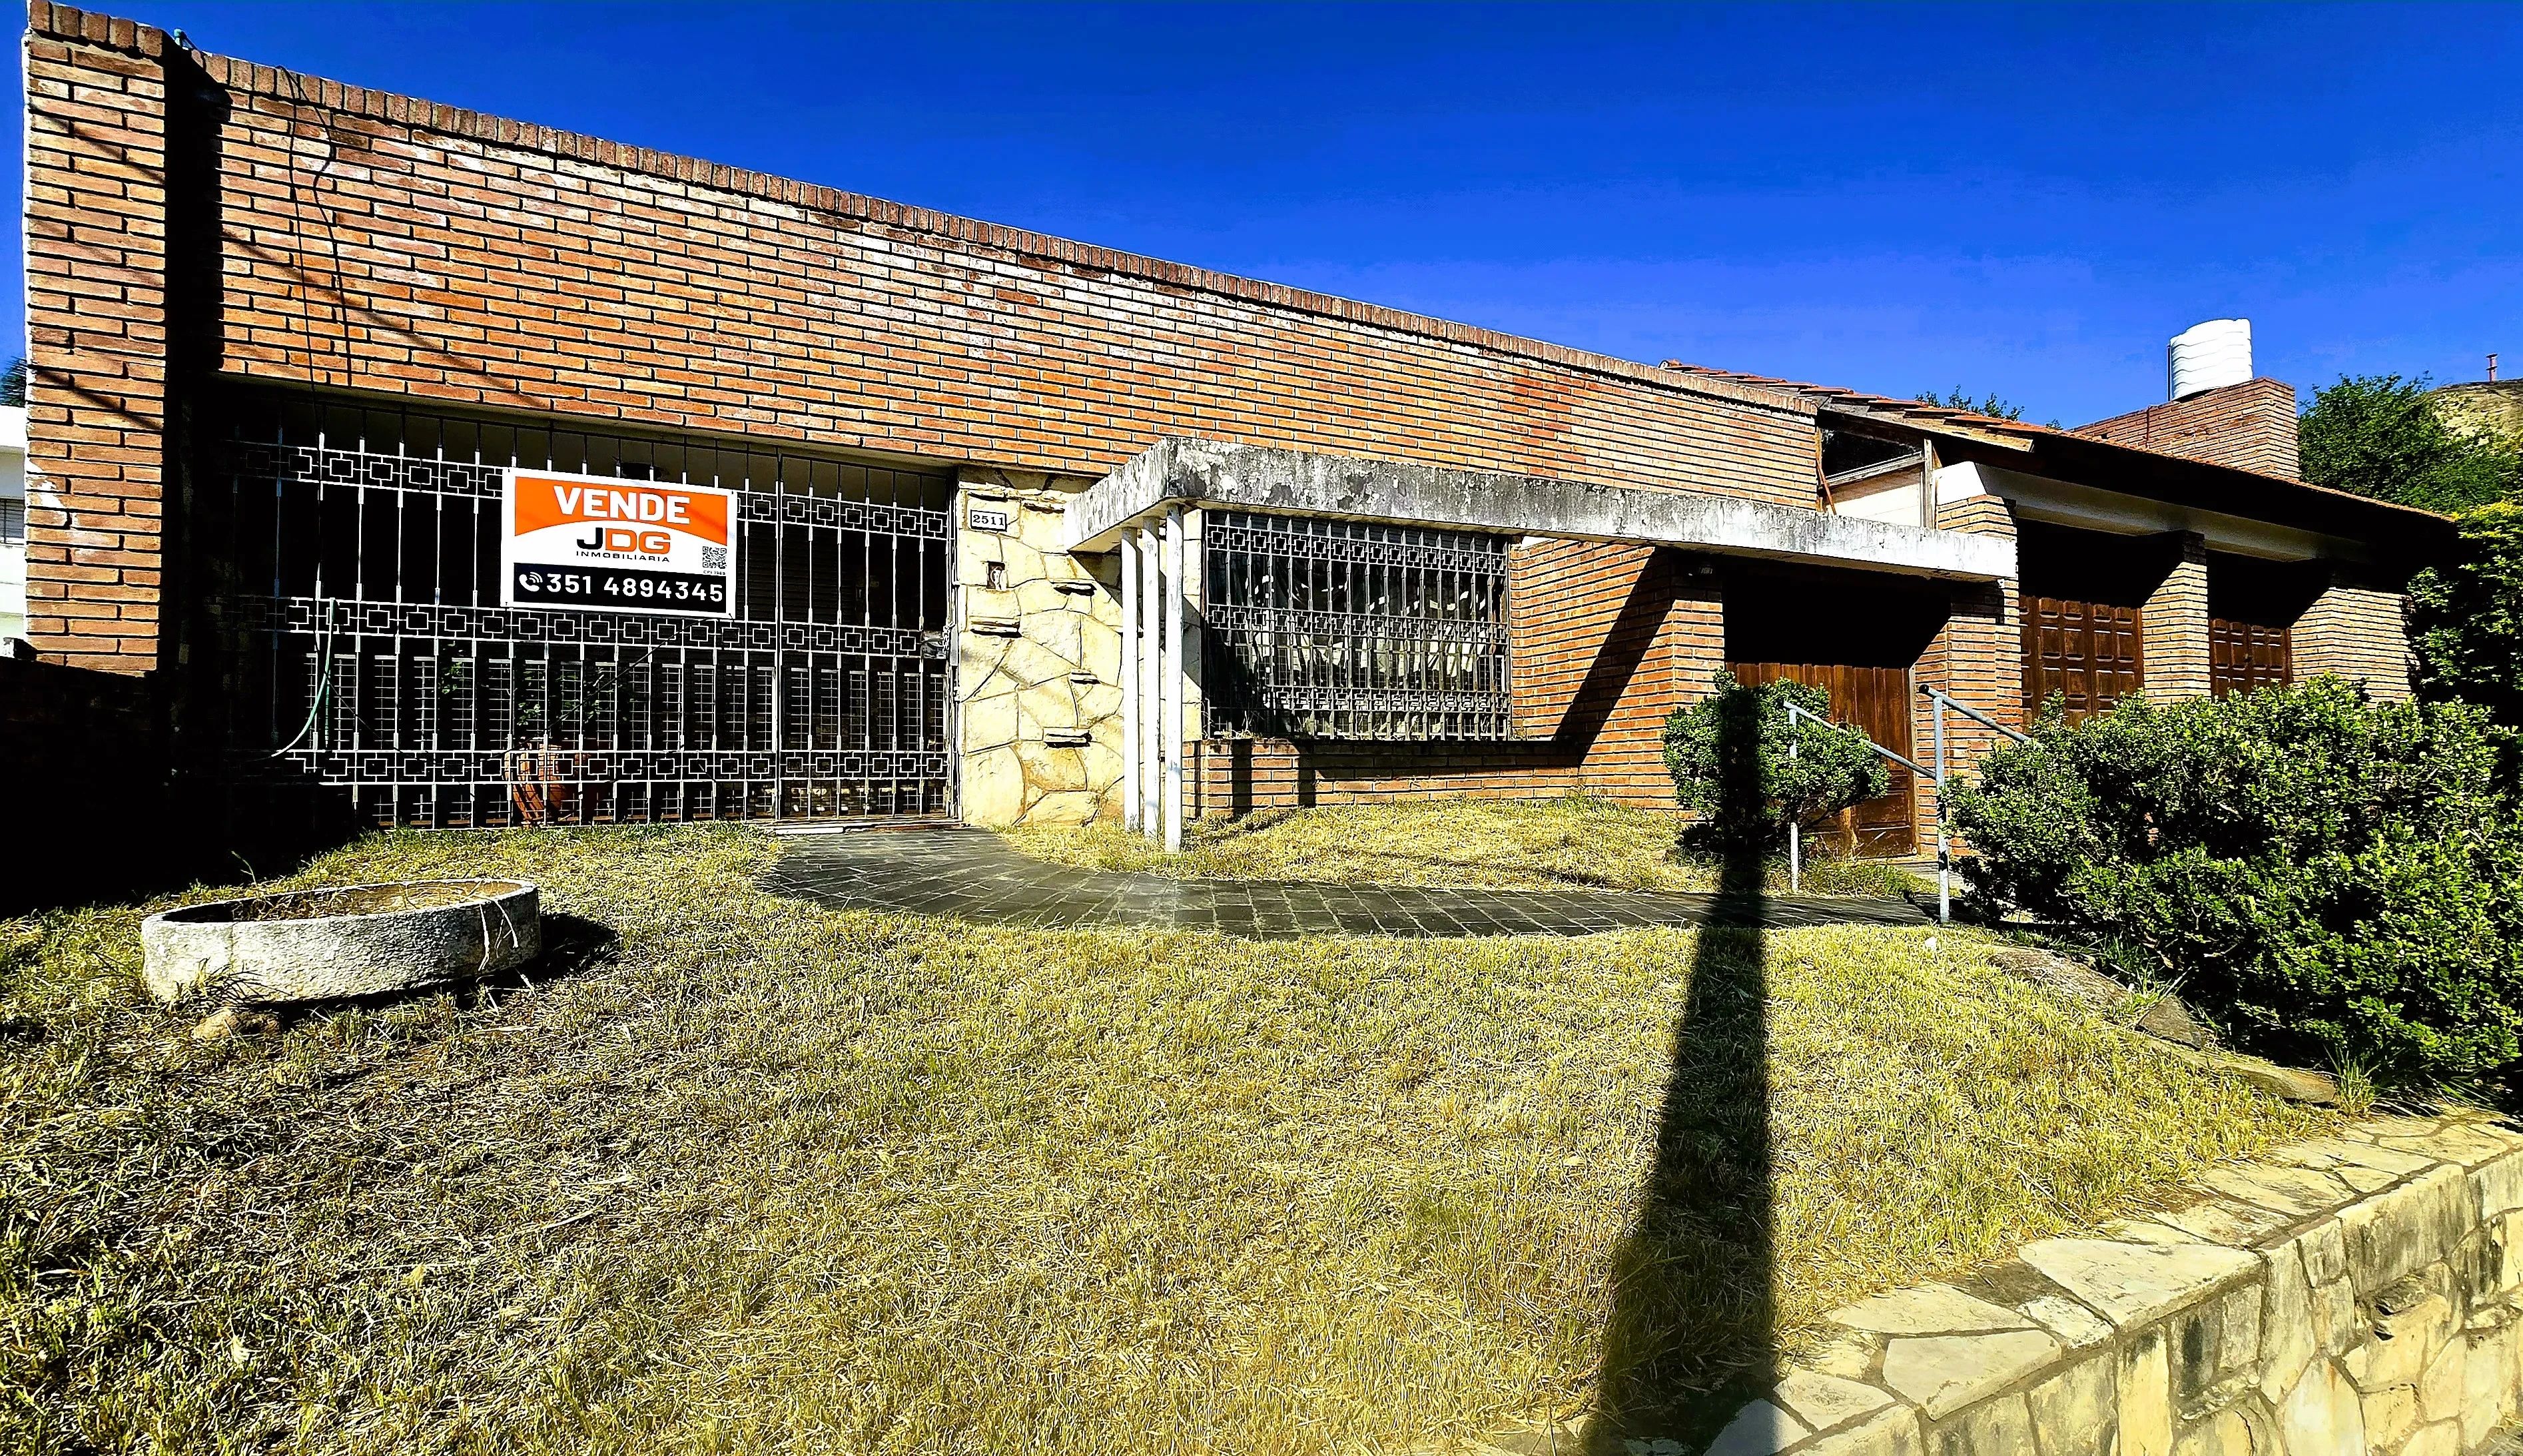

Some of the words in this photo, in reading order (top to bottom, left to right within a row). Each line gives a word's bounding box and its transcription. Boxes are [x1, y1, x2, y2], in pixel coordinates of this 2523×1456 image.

[553, 485, 690, 524] VENDE
[973, 514, 1004, 526] 2511
[577, 528, 671, 554] JDG
[576, 551, 669, 562] INMOBILIARIA
[547, 573, 591, 594] 351
[603, 577, 723, 601] 4894345
